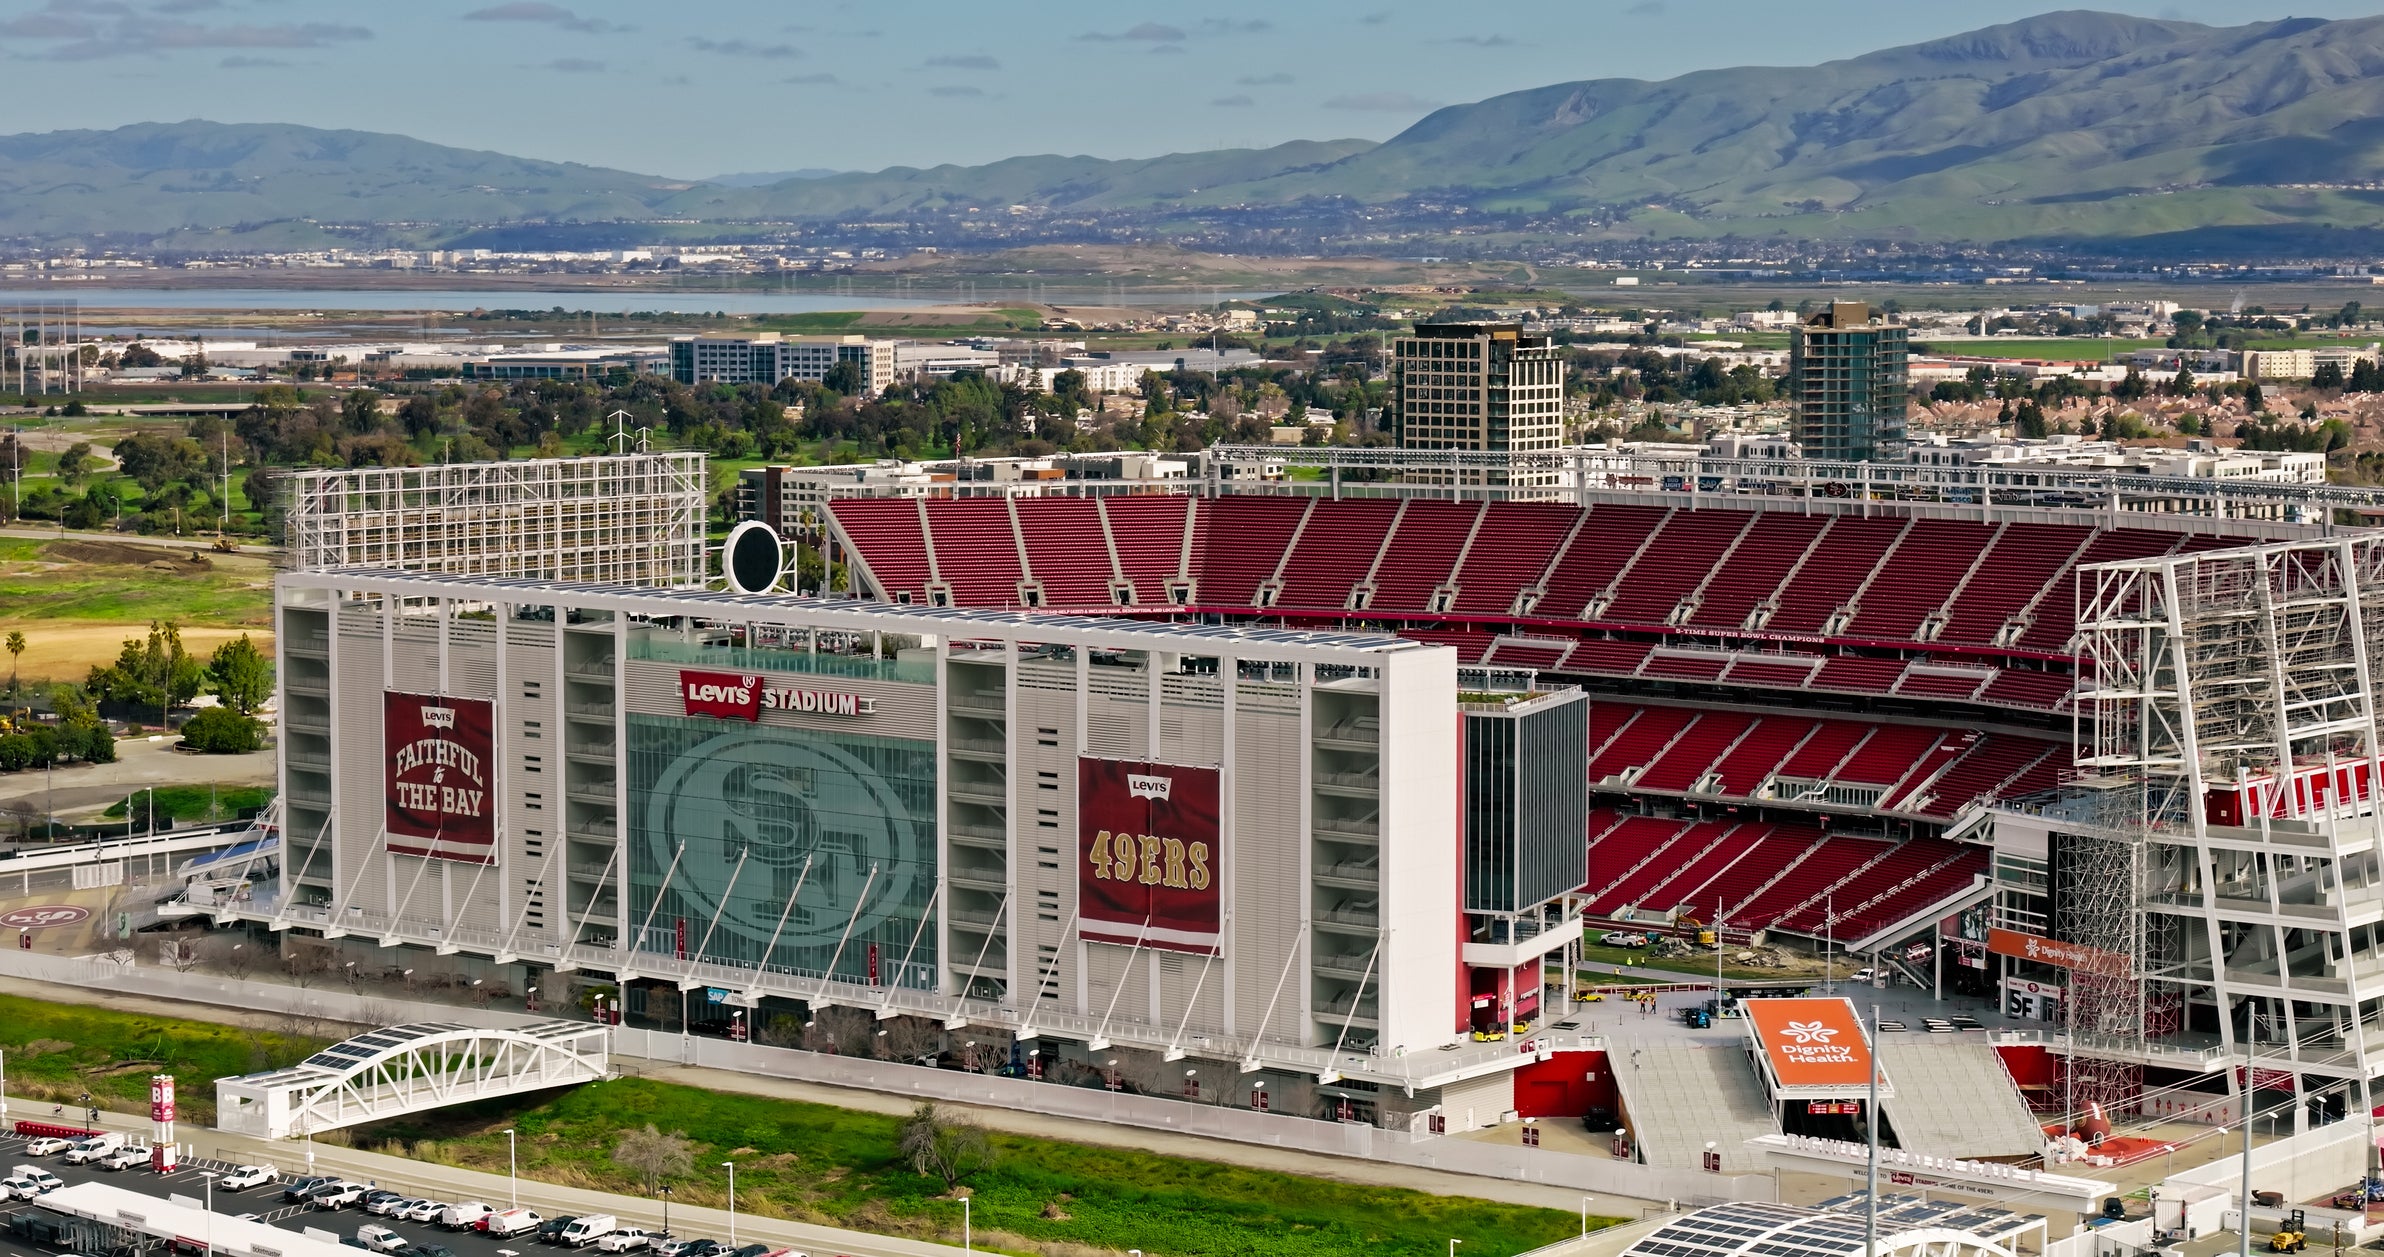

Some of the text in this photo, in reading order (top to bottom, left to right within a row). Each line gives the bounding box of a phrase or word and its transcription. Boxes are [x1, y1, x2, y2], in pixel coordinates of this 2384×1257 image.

[1699, 479, 1717, 489] SAP
[1708, 630, 1738, 638] SUPER
[1740, 632, 1767, 640] BOWL
[1769, 634, 1825, 644] CHAMPIONS
[765, 688, 858, 716] STADIUM
[396, 739, 483, 788] FAITHFUL
[433, 766, 446, 784] to
[396, 781, 484, 817] THE BAY
[1089, 829, 1211, 891] 49ERS
[708, 990, 724, 1003] SAP
[2010, 990, 2034, 1017] SF
[1781, 1045, 1851, 1056] Dignity
[1786, 1132, 1870, 1157] DIGNITY
[1966, 1159, 2019, 1181] GATE
[1977, 1187, 1995, 1196] 49ERS
